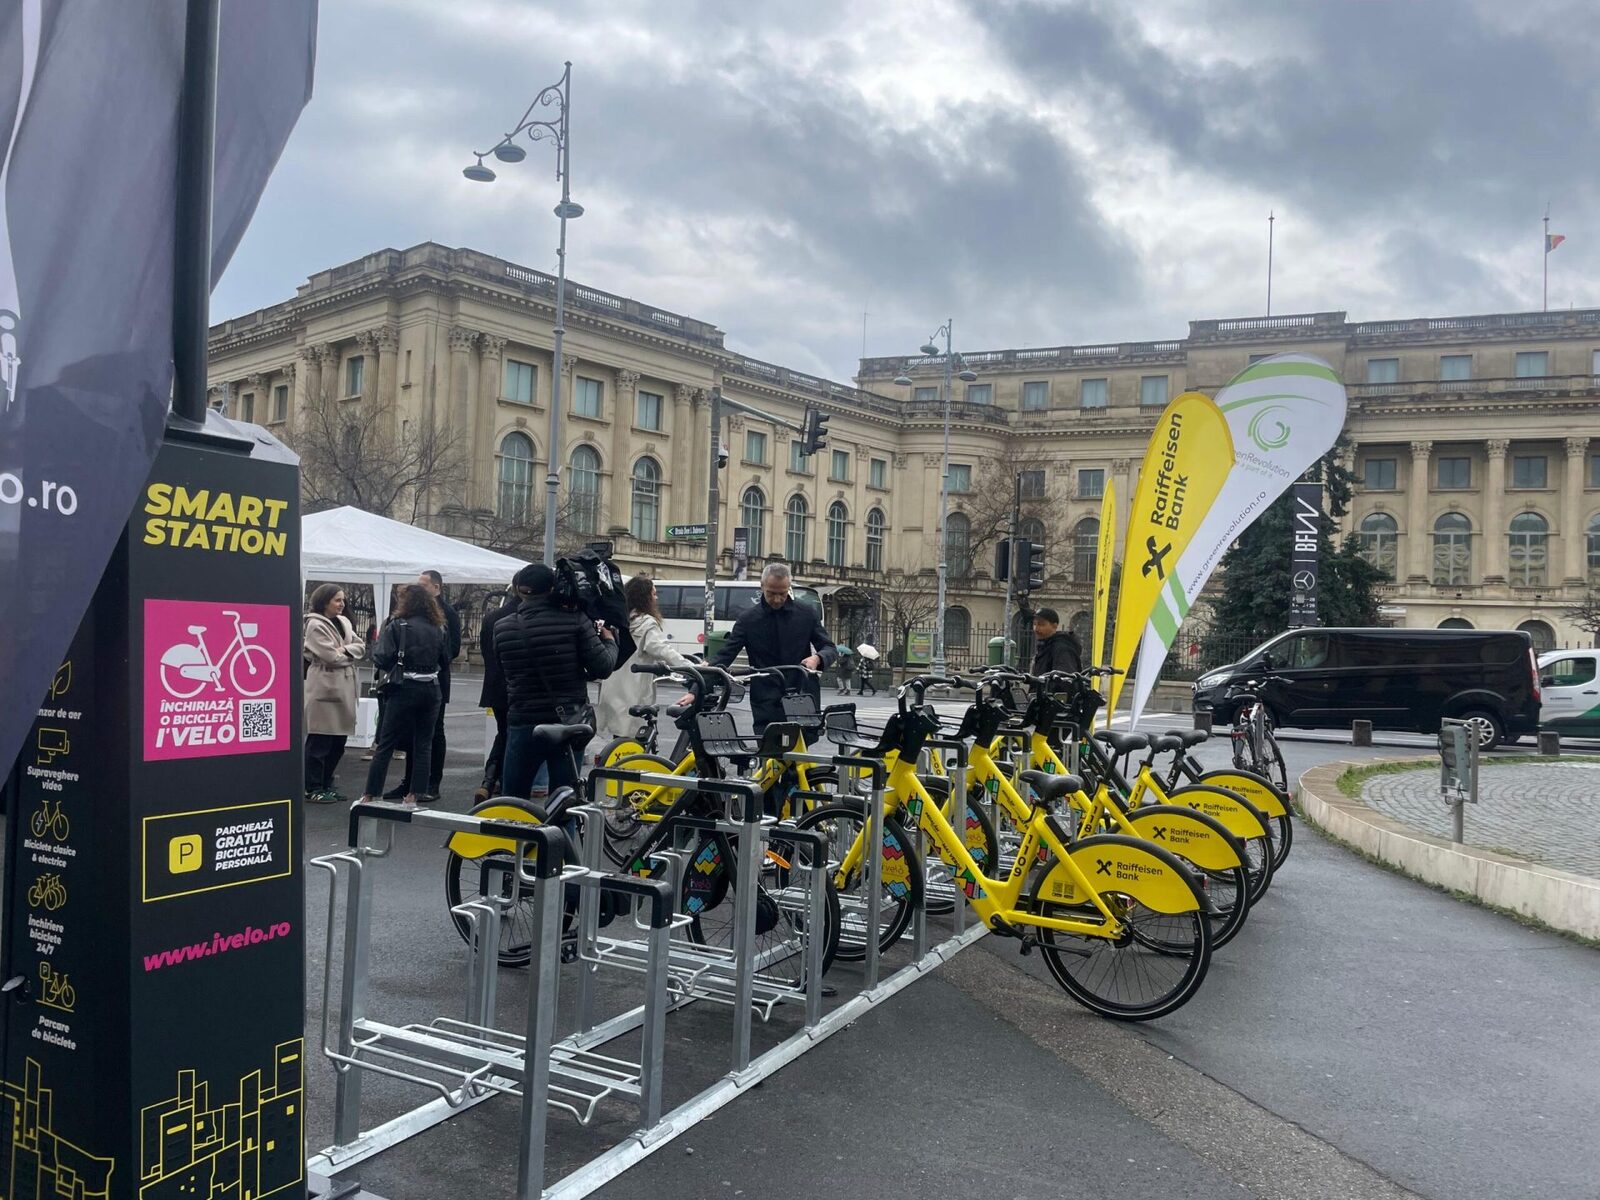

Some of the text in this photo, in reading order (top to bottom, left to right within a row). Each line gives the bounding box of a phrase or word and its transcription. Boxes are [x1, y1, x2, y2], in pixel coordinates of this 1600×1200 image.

[1150, 412, 1183, 526] Raiffeisen
[1236, 451, 1290, 478] enRevolution
[144, 482, 289, 529] SMART
[1165, 473, 1189, 531] Bank
[143, 518, 288, 557] STATION
[1187, 491, 1267, 594] www.greenrevolution.ro
[38, 708, 82, 720] nzor de aer
[159, 697, 235, 713] ÎNCHIRIAZĂ
[160, 710, 235, 726] O BICICLETĂ
[155, 724, 237, 749] I'VELO
[26, 765, 80, 782] Supraveghere
[41, 779, 64, 792] video
[1231, 785, 1263, 795] Raiffeisen
[1203, 802, 1238, 813] Raiffeisen
[215, 818, 274, 837] PARCHEAZĂ
[1170, 827, 1210, 840] Raiffeisen
[23, 839, 77, 857] Biciclete clasice
[215, 829, 274, 850] GRATUIT
[1169, 835, 1190, 844] Bank
[38, 854, 68, 868] electrice
[215, 843, 269, 861] BICICLETA
[215, 851, 273, 871] PERSONALĂ
[1013, 833, 1033, 877] 1109
[1116, 861, 1163, 876] Raiffeisen
[1116, 870, 1140, 881] Bank
[28, 913, 65, 934] Închiriere
[29, 928, 62, 945] biciclete
[36, 942, 55, 956] 24/7
[143, 920, 291, 972] www.ivelo.ro
[38, 1015, 70, 1034] Parcare
[31, 1028, 77, 1051] de biciclete
